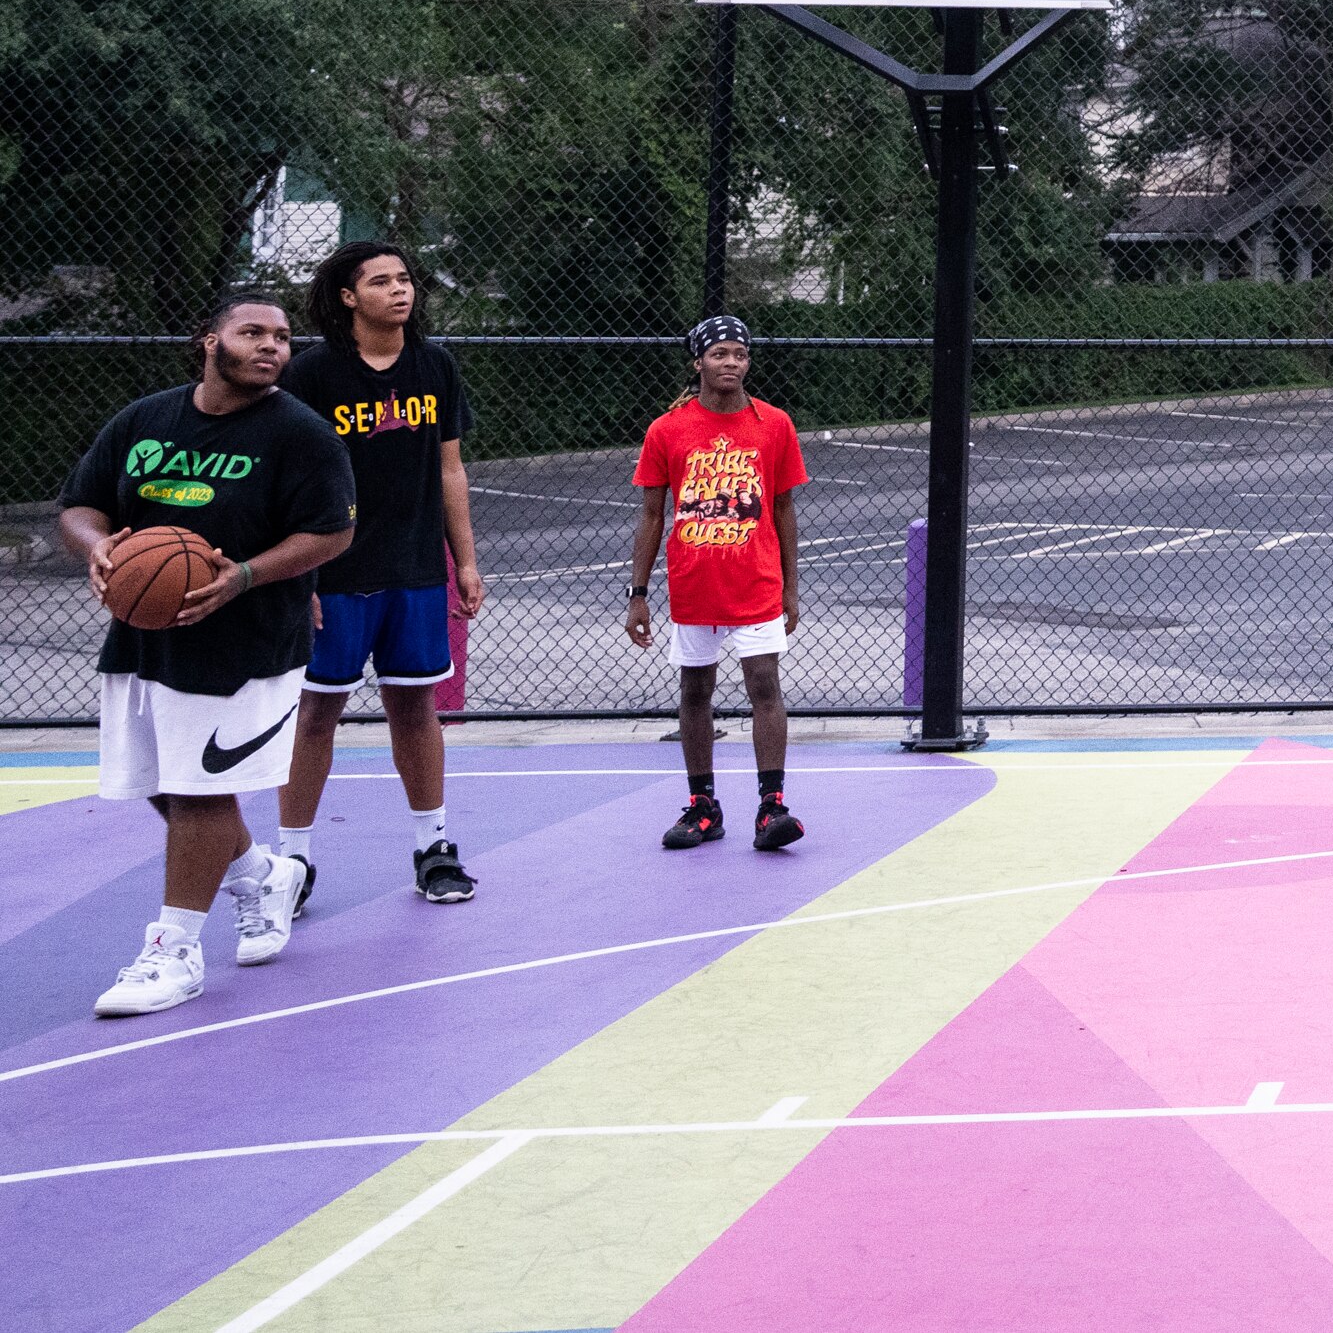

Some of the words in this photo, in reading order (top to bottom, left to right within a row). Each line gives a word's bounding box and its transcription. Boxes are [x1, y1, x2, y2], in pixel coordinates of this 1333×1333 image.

[160, 450, 253, 479] AVID
[687, 449, 758, 480] TRIBE
[140, 484, 172, 499] Class
[174, 487, 186, 501] of
[186, 486, 212, 501] 2023
[680, 519, 758, 546] QUEST
